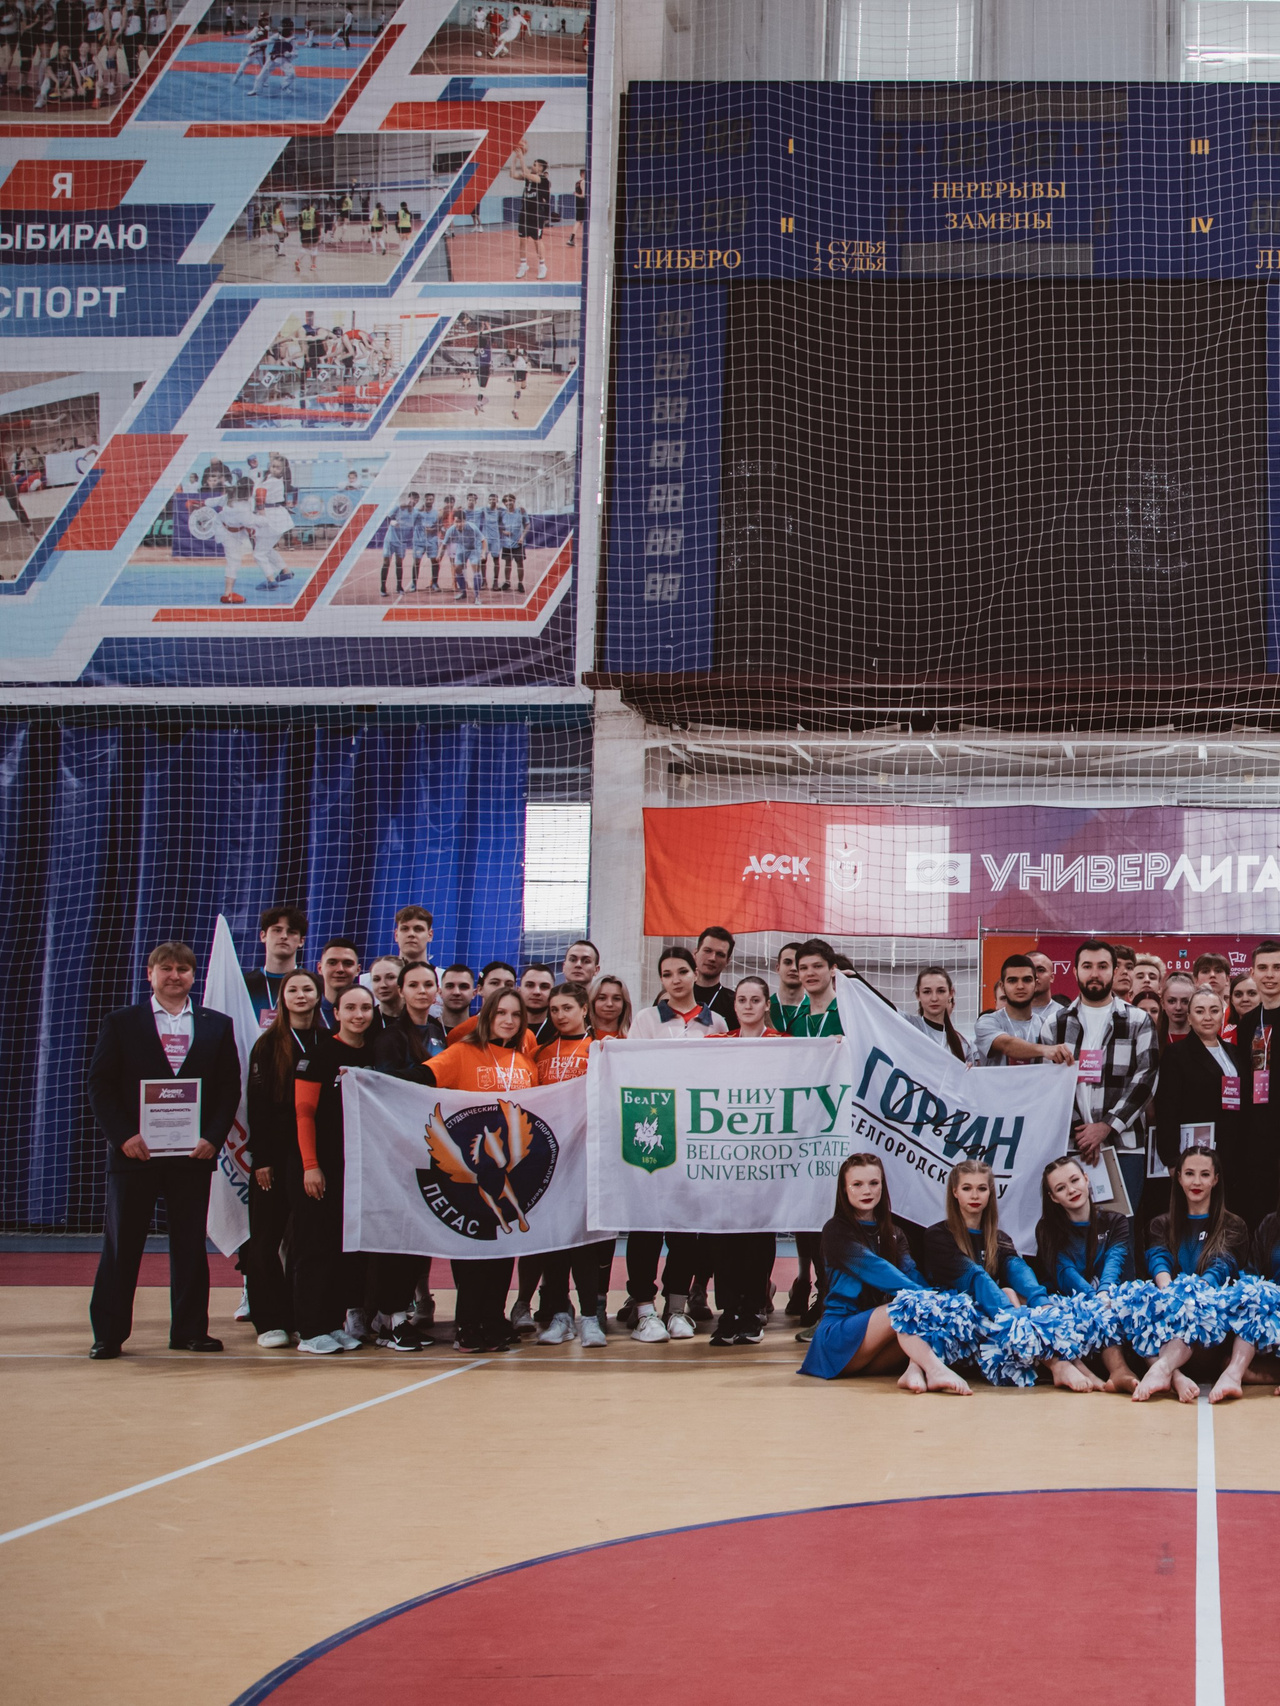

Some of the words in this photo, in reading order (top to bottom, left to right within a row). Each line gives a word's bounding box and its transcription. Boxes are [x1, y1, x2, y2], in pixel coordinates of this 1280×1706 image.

[1190, 139, 1210, 155] III
[52, 172, 73, 199] Я
[932, 181, 1067, 199] ПЕРЕРЫВЫ
[944, 212, 1053, 230] ЗАМЕНЫ
[1190, 217, 1214, 233] IV
[0, 224, 148, 250] ЫБИРАЮ
[828, 241, 887, 255] СУДЬЯ
[633, 249, 742, 270] ЛИБЕРО
[813, 257, 822, 271] 2
[828, 257, 887, 272] СУДЬЯ
[742, 853, 812, 876] АССК
[1167, 960, 1196, 970] СВО
[624, 1090, 672, 1106] БелГУ
[727, 1088, 778, 1105] НИУ
[445, 1105, 499, 1129] СТУДЕНЧЕСКИЙ
[685, 1084, 852, 1136] БелГУ
[856, 1046, 1025, 1170] ГОРИН
[686, 1143, 793, 1160] BELGOROD
[799, 1141, 850, 1158] STATE
[852, 1114, 949, 1185] ЕЛГОРОДСК
[641, 1156, 658, 1165] 1876
[686, 1162, 801, 1181] UNIVERSITY
[807, 1160, 842, 1179] (BSU
[423, 1182, 480, 1236] ПЕГАС
